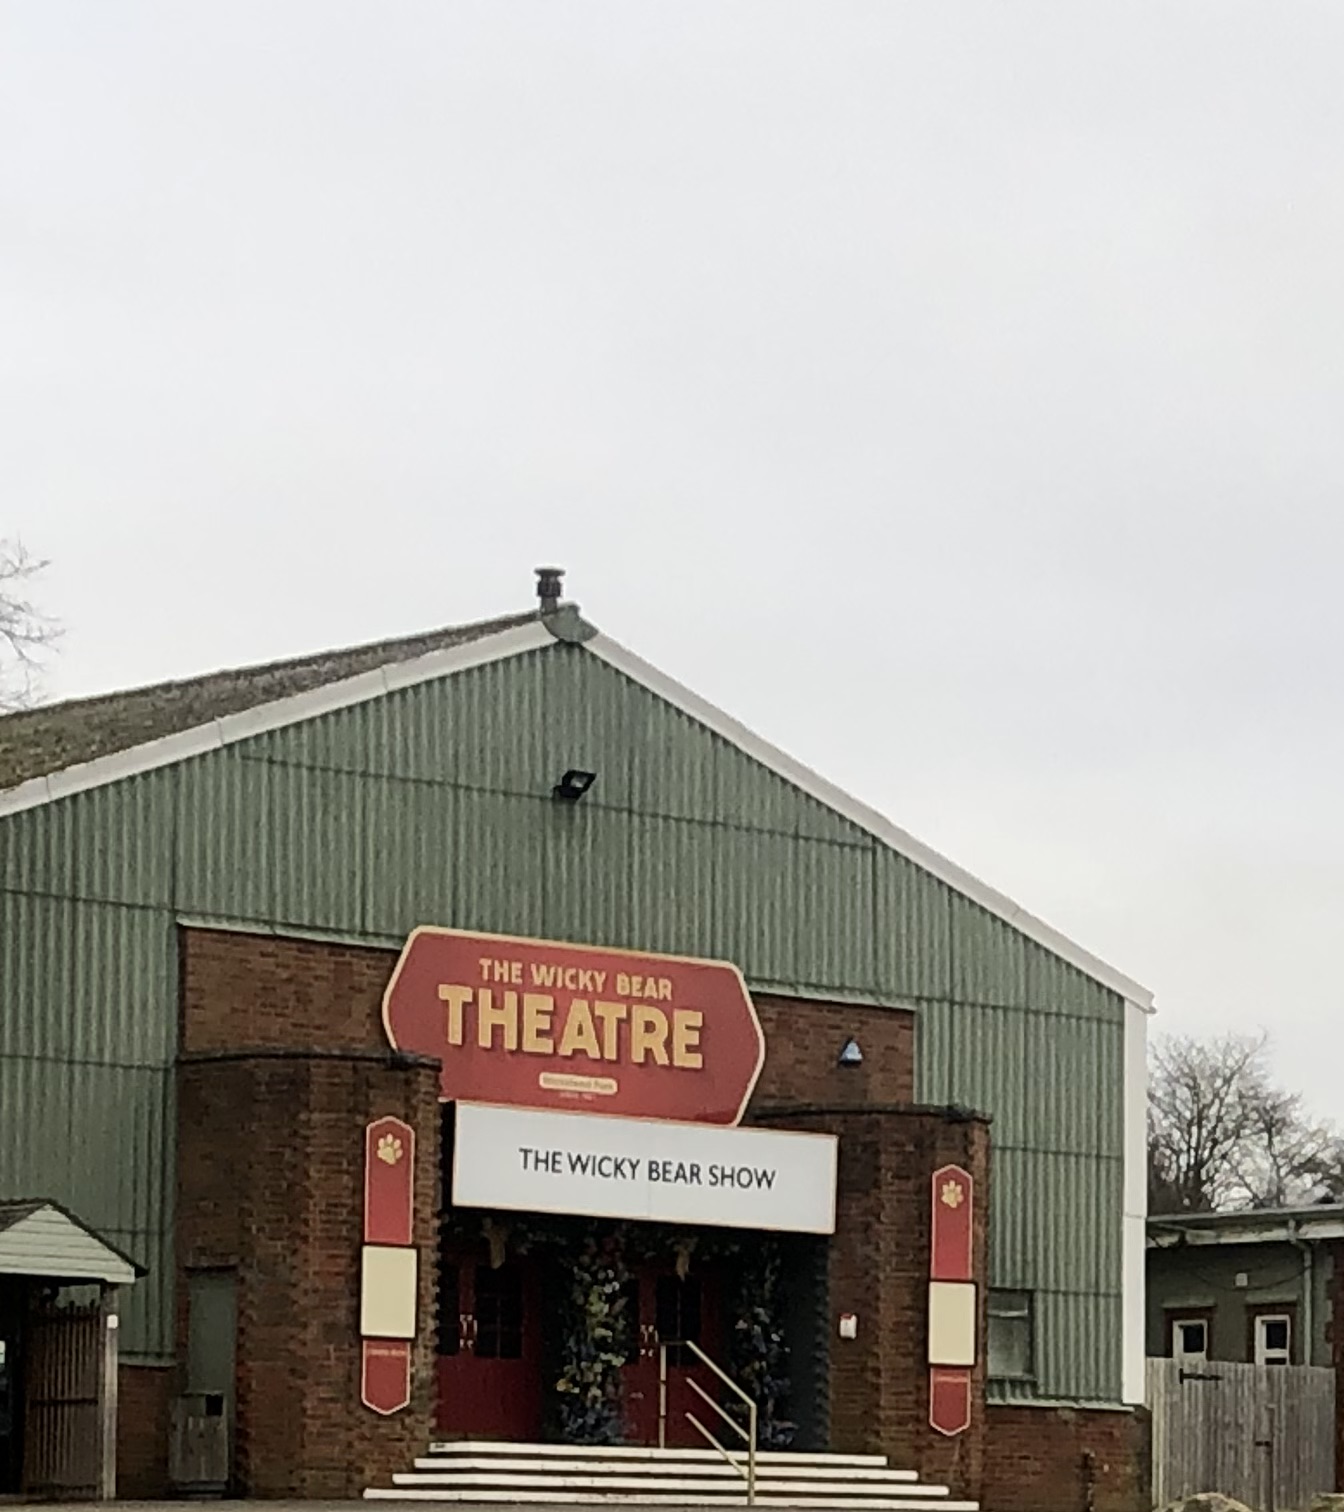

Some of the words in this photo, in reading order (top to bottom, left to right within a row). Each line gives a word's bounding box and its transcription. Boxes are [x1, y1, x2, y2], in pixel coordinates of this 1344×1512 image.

[479, 957, 523, 985] THE
[531, 963, 606, 993] WICKY
[616, 972, 672, 1001] BEAR
[438, 983, 703, 1069] THEATRE
[518, 1147, 563, 1174] THE
[567, 1152, 641, 1180] WICKY
[647, 1159, 702, 1185] BEAR
[708, 1164, 776, 1190] SHOW
